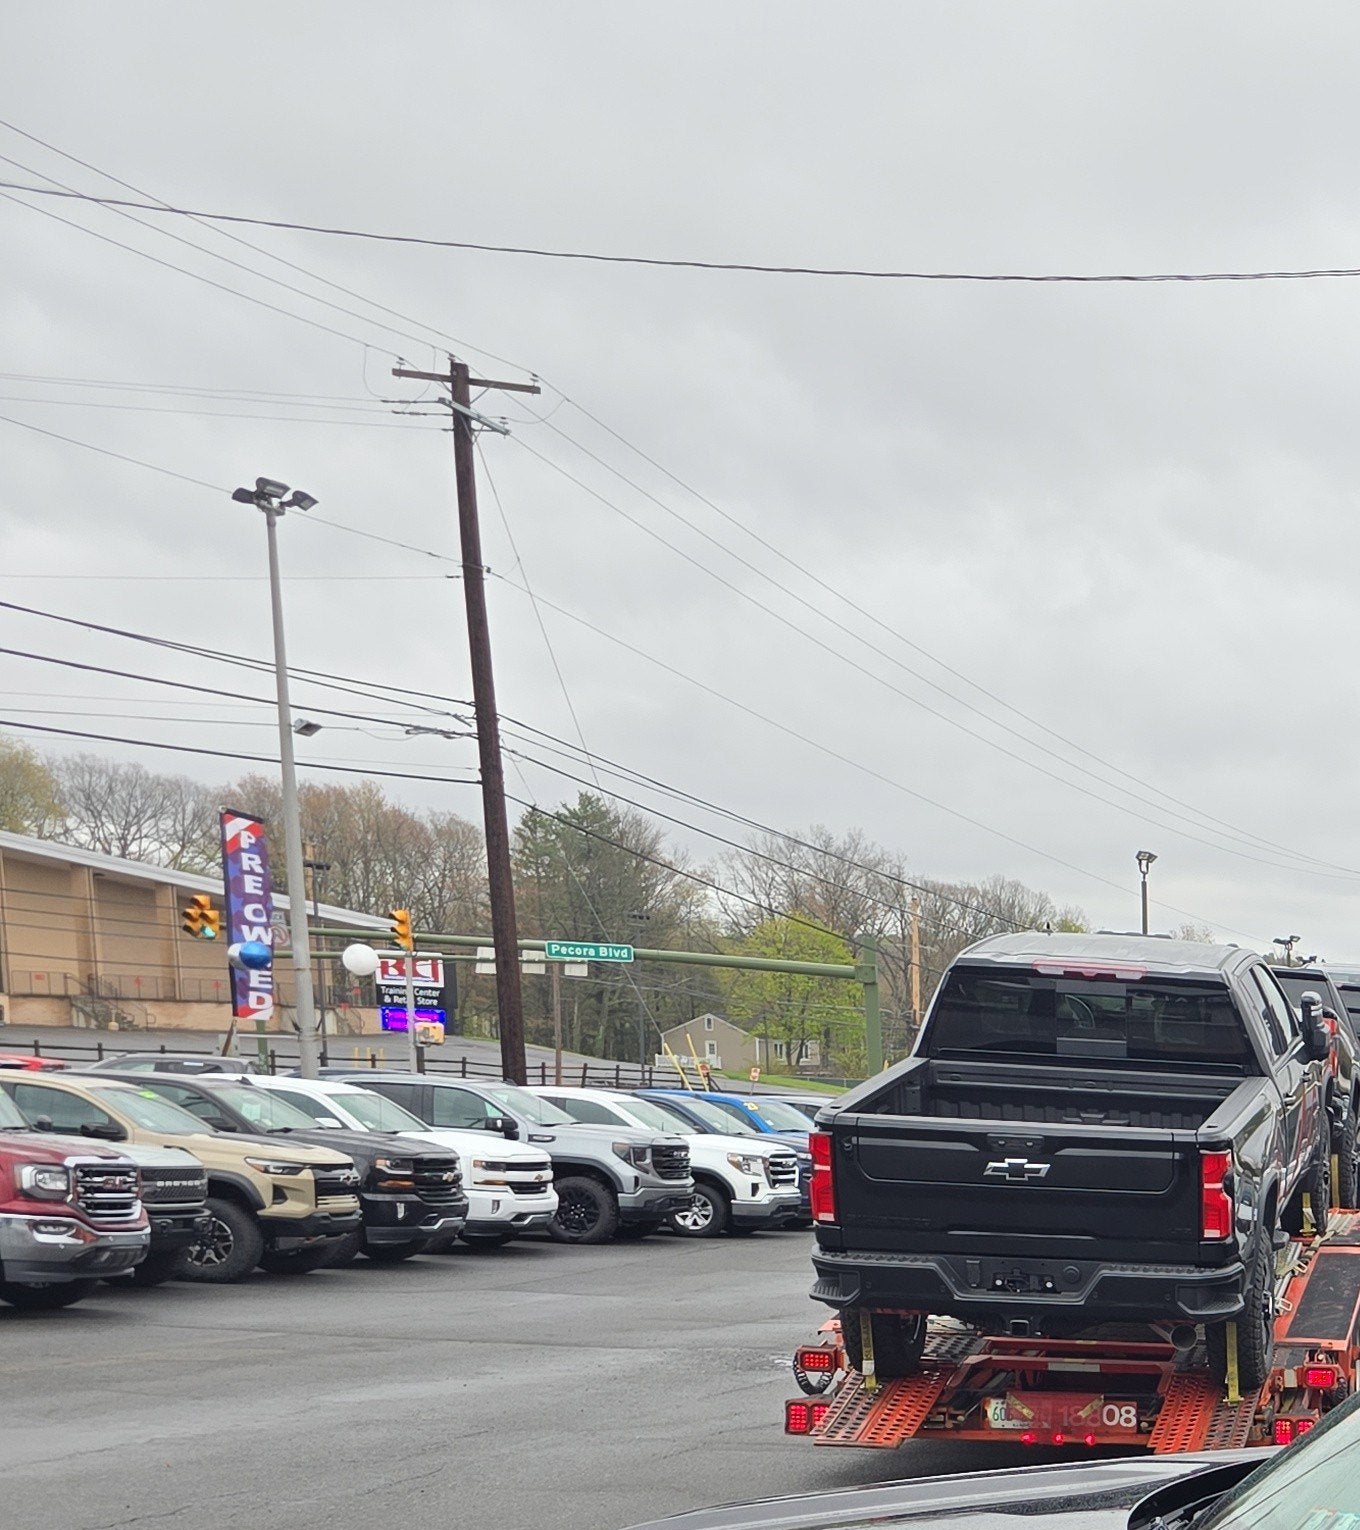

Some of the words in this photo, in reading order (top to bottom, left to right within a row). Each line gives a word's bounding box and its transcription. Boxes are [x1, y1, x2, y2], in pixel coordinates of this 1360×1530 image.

[241, 903, 273, 1010] OWED
[551, 944, 596, 956] Pecora
[599, 946, 628, 958] Blvd
[381, 986, 408, 995] Trainin
[414, 988, 440, 997] Center
[416, 997, 438, 1006] Store
